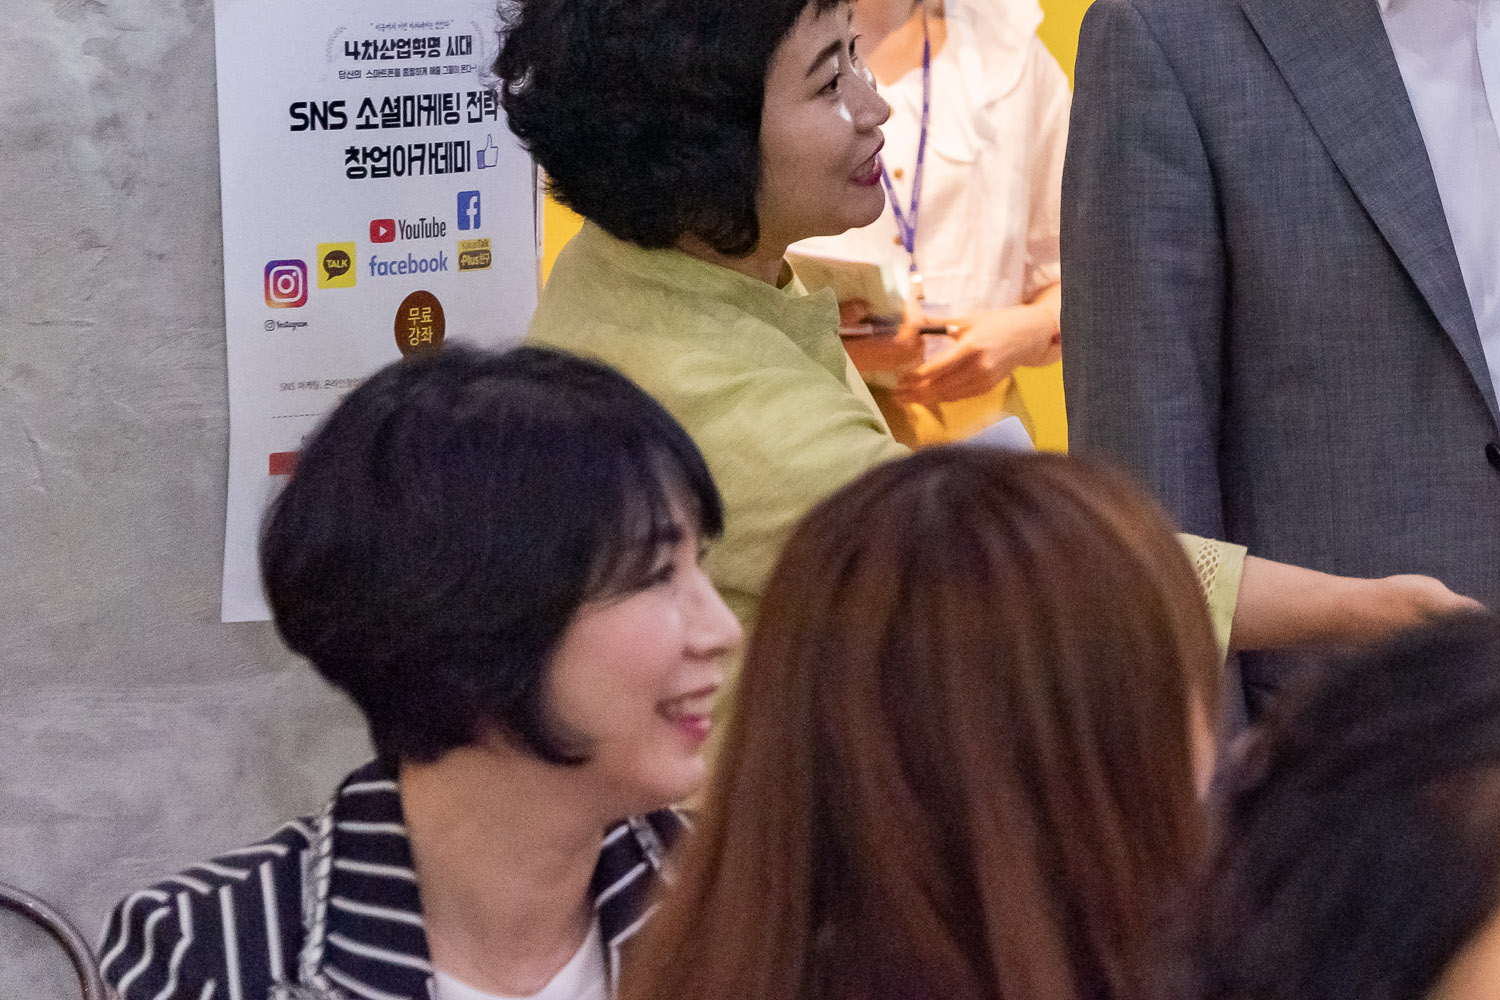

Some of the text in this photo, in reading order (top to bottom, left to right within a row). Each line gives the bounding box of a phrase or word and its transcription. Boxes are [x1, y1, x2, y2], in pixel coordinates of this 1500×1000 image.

[344, 34, 472, 60] 4차산업혁명 시대
[338, 69, 362, 80] 당신의
[365, 67, 401, 79] 스마트폰을
[289, 90, 498, 132] SNS 소셜마케팅 전략
[344, 139, 471, 180] 창업아카데미
[398, 216, 446, 241] YouTube
[325, 259, 349, 269] TALK
[369, 250, 448, 277] facebook
[407, 306, 434, 325] 무료
[407, 326, 434, 347] 강좌
